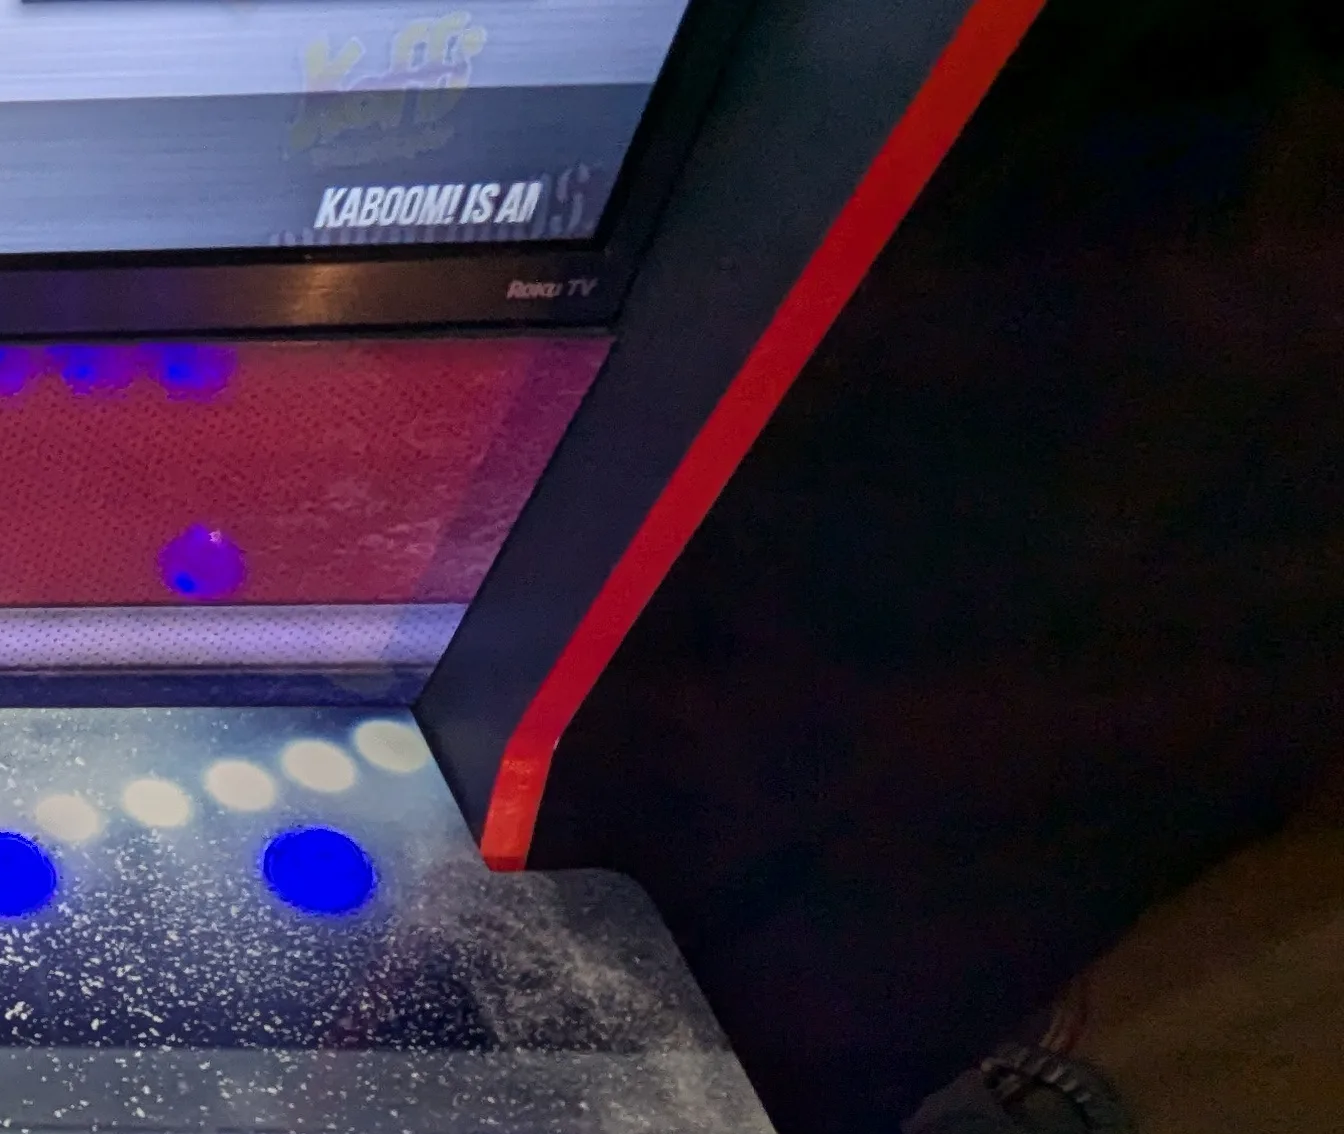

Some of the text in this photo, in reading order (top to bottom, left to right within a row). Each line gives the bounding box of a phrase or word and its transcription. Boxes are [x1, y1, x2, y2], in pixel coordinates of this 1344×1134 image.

[313, 182, 463, 229] KABOOM!
[459, 182, 502, 225] IS
[567, 279, 598, 297] TV
